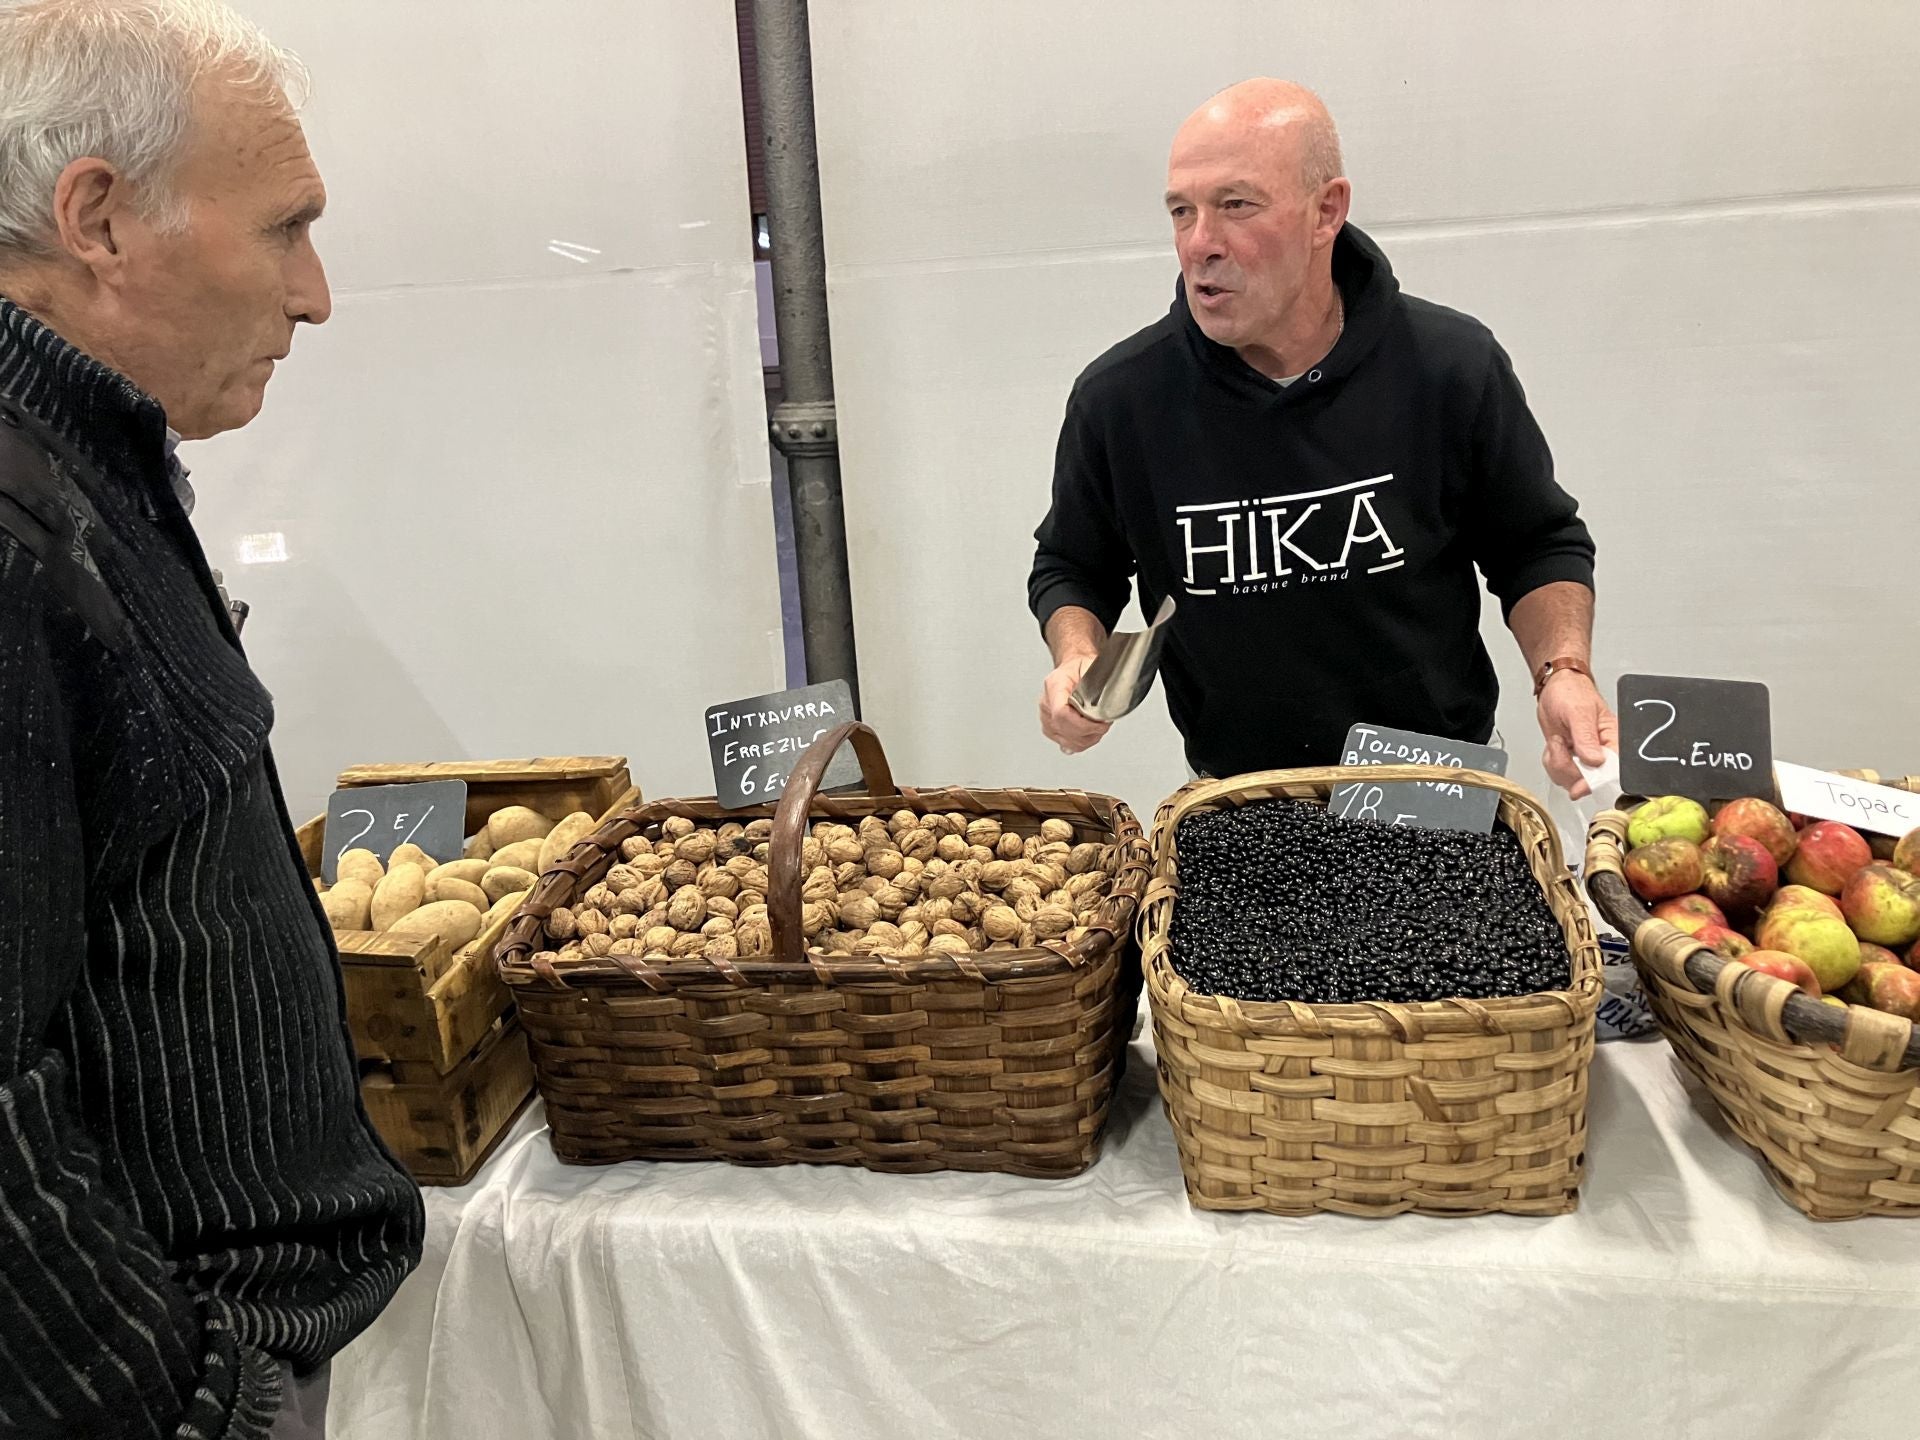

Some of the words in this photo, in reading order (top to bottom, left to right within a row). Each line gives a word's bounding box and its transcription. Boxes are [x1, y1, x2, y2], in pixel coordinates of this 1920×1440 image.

[1232, 579, 1289, 595] basque
[1301, 569, 1349, 584] brand
[708, 701, 836, 737] INTXAURRA
[740, 765, 758, 796] 6
[1813, 780, 1910, 820] Topac
